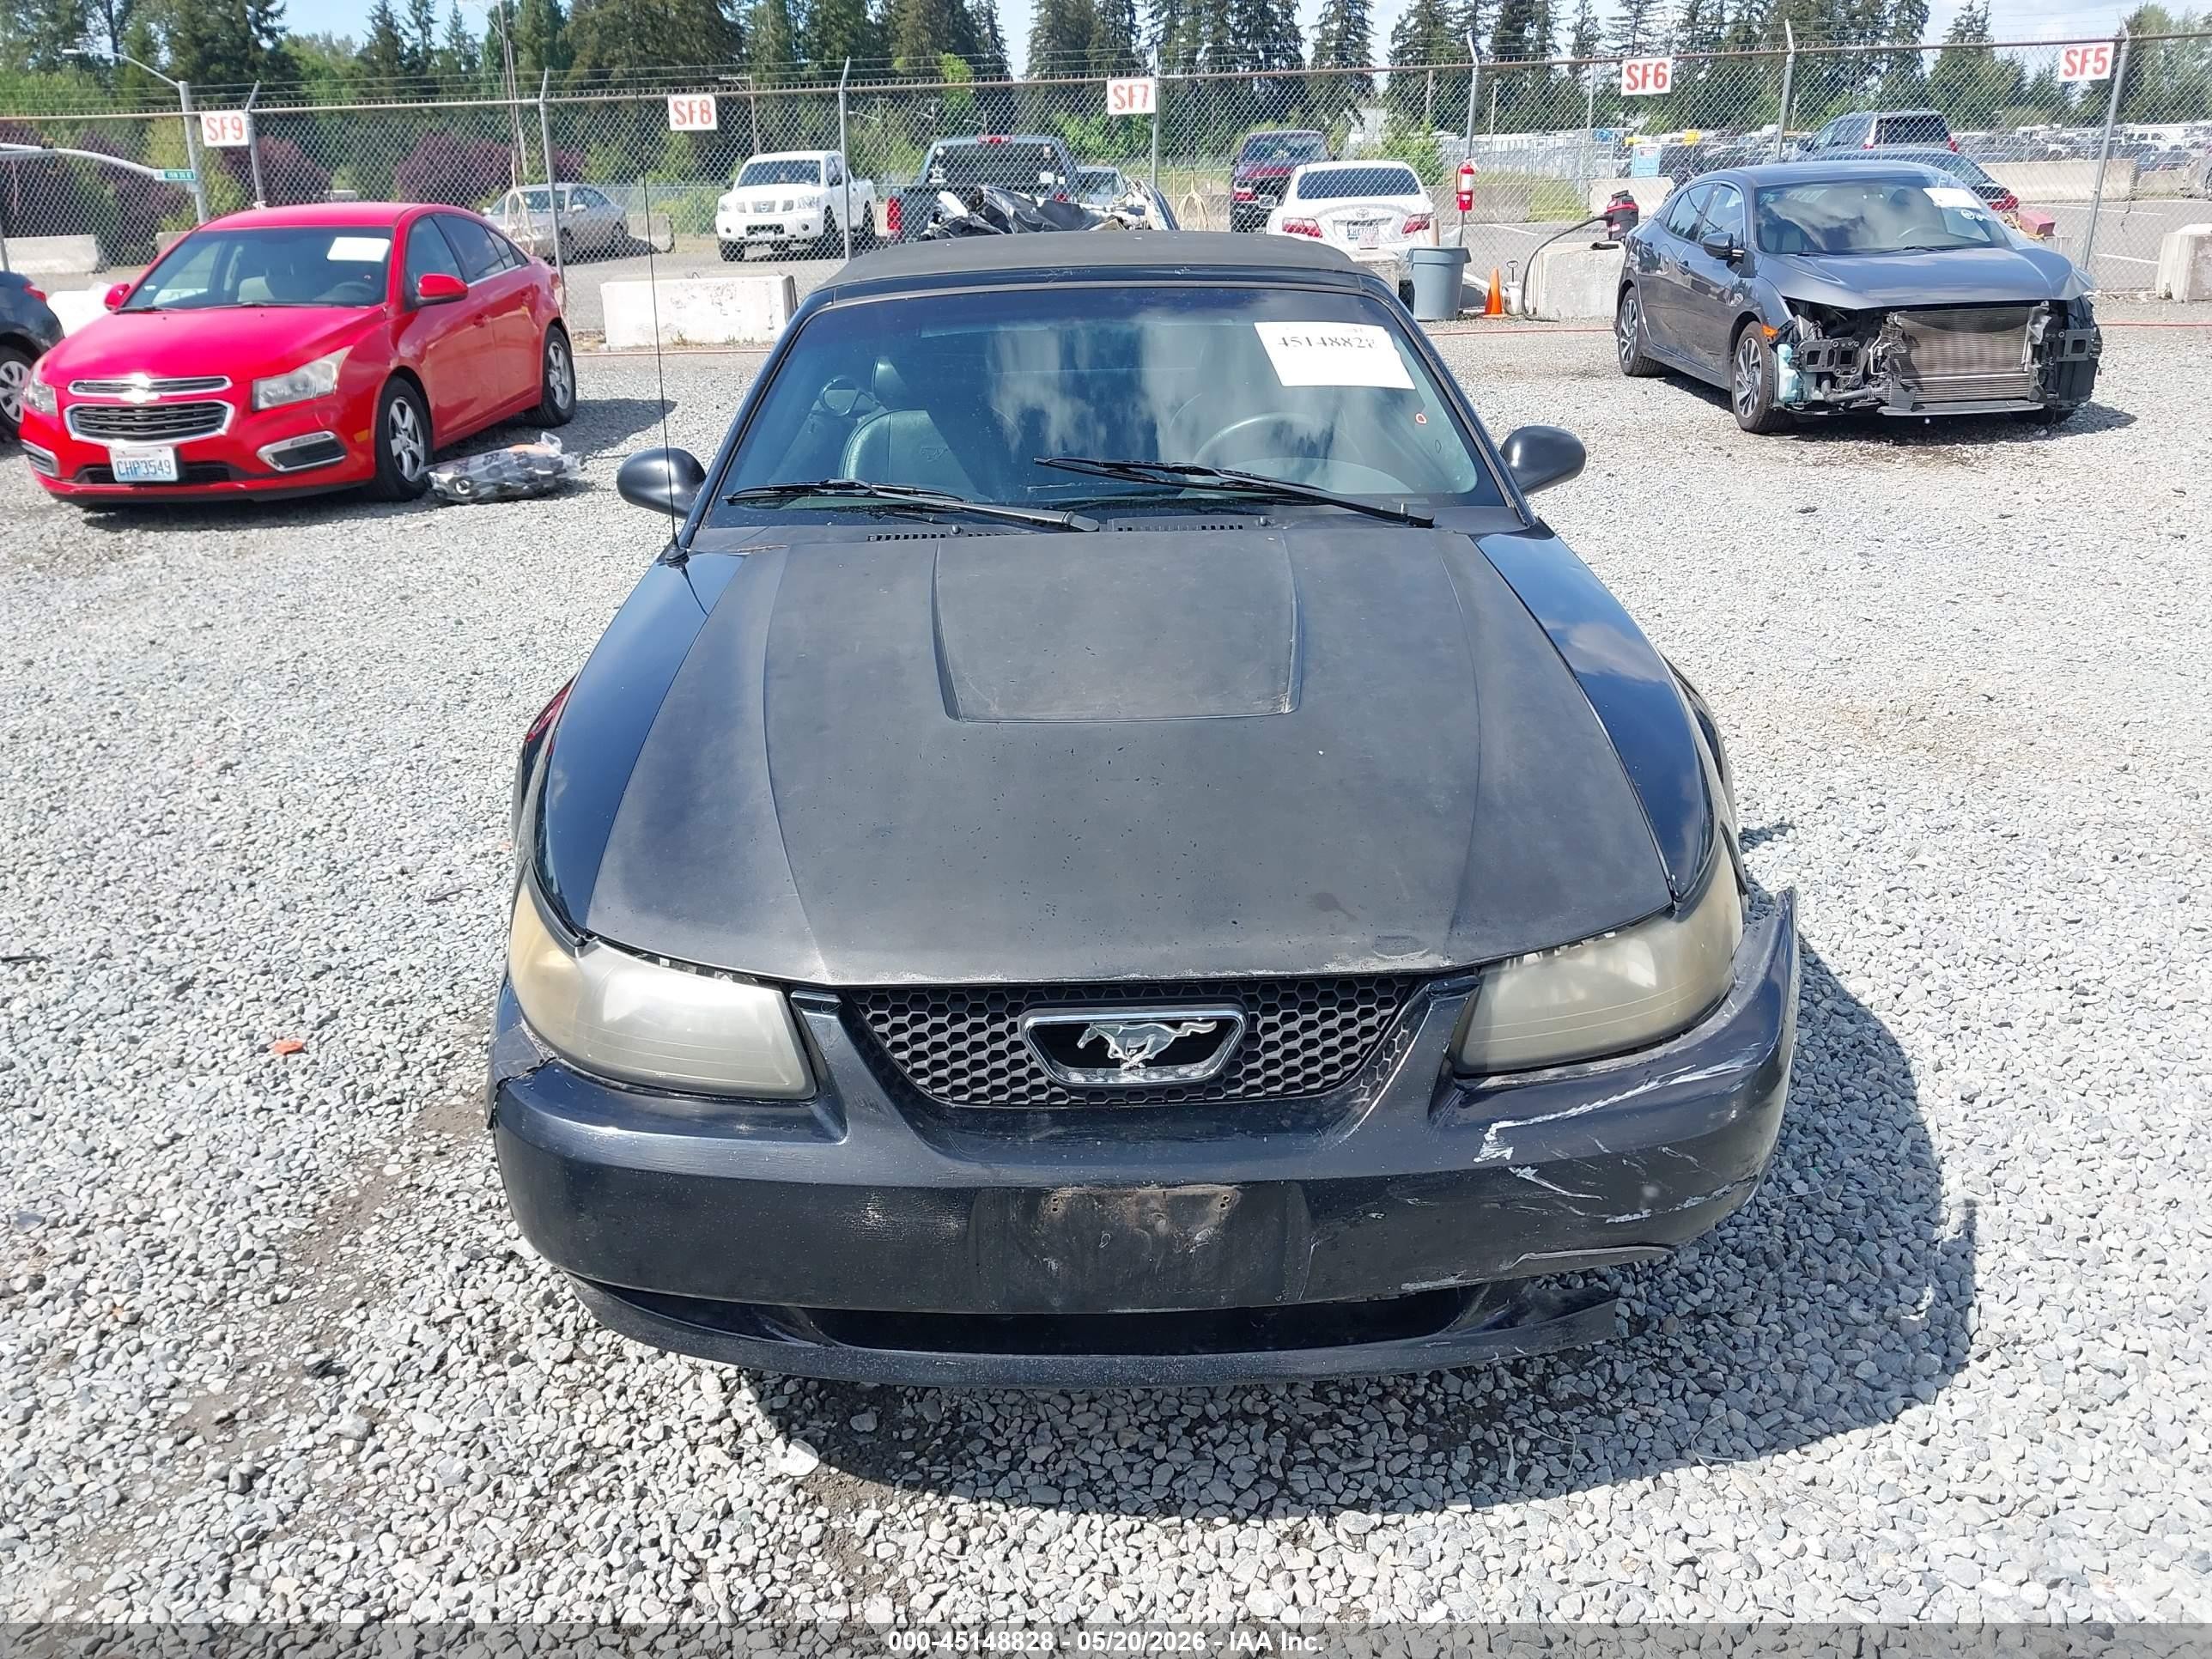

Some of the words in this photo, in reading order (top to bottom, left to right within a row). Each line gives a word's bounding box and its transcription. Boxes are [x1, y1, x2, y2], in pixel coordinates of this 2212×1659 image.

[2063, 46, 2109, 76] SF5
[1626, 62, 1667, 90] SF6
[1113, 83, 1149, 110] SF7
[673, 99, 712, 125] SF8
[206, 115, 243, 141] SF9
[116, 459, 172, 476] CHP3549
